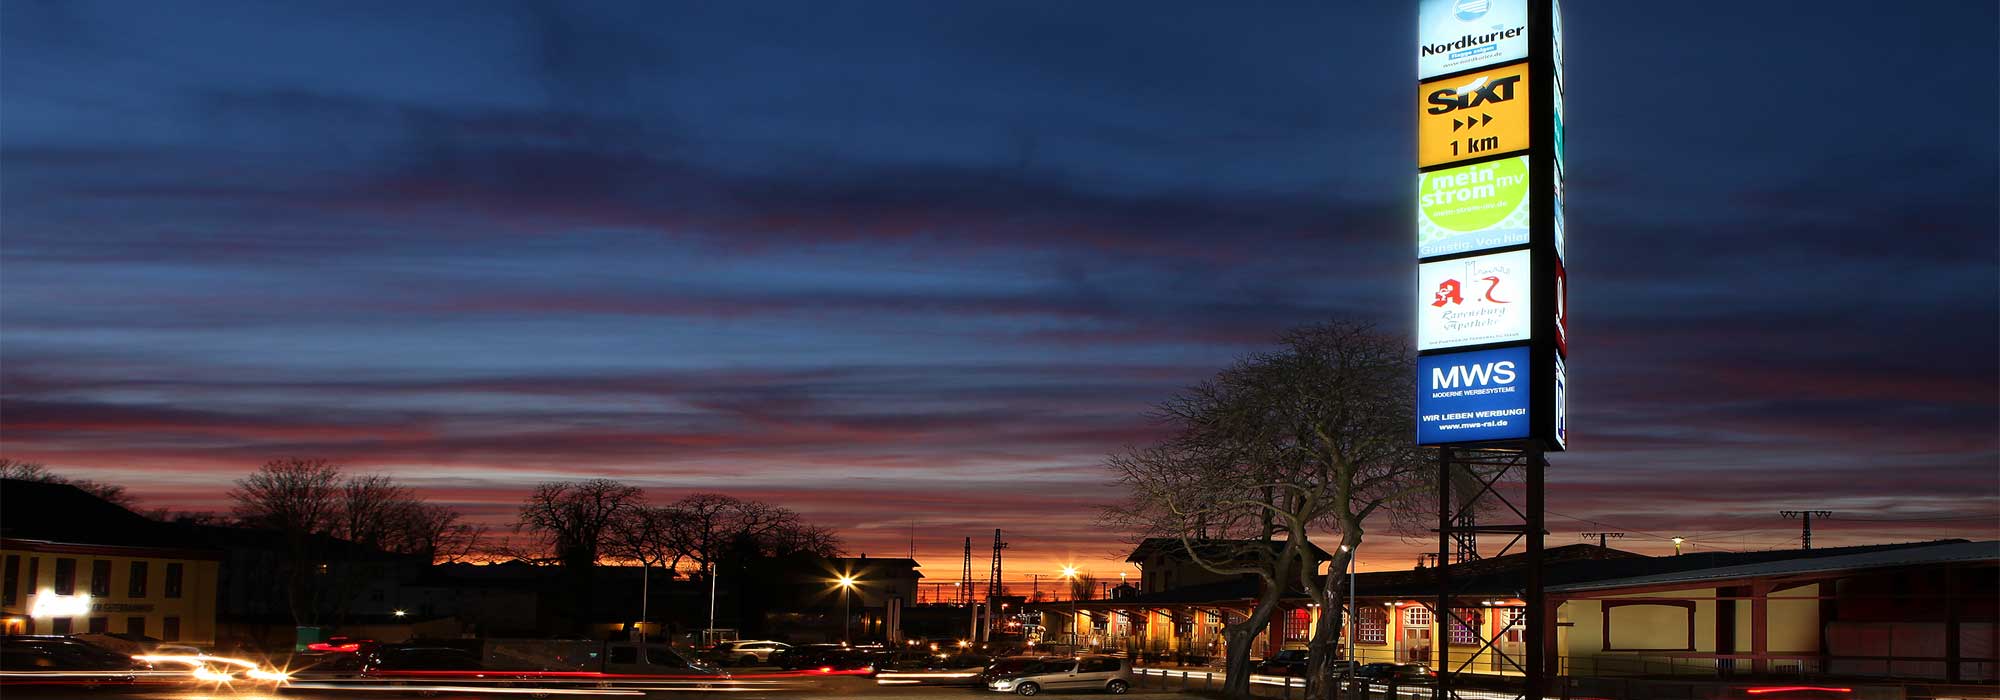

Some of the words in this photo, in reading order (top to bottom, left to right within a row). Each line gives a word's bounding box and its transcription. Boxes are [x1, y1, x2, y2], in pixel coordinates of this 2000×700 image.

[1422, 26, 1525, 57] Nordkurier
[1450, 140, 1458, 156] 1
[1468, 136, 1498, 153] km
[1432, 166, 1494, 190] mein
[1496, 174, 1525, 188] mv
[1421, 184, 1495, 207] strom
[1475, 237, 1501, 247] Von
[1442, 307, 1506, 321] Ravensburg
[1444, 318, 1500, 331] Apotheke
[1432, 361, 1516, 390] MWS
[1432, 390, 1463, 398] MODERNE
[1464, 386, 1515, 396] WERBESYSTEME
[1442, 411, 1474, 420] LIEBEN
[1475, 408, 1526, 418] WERBUNG!
